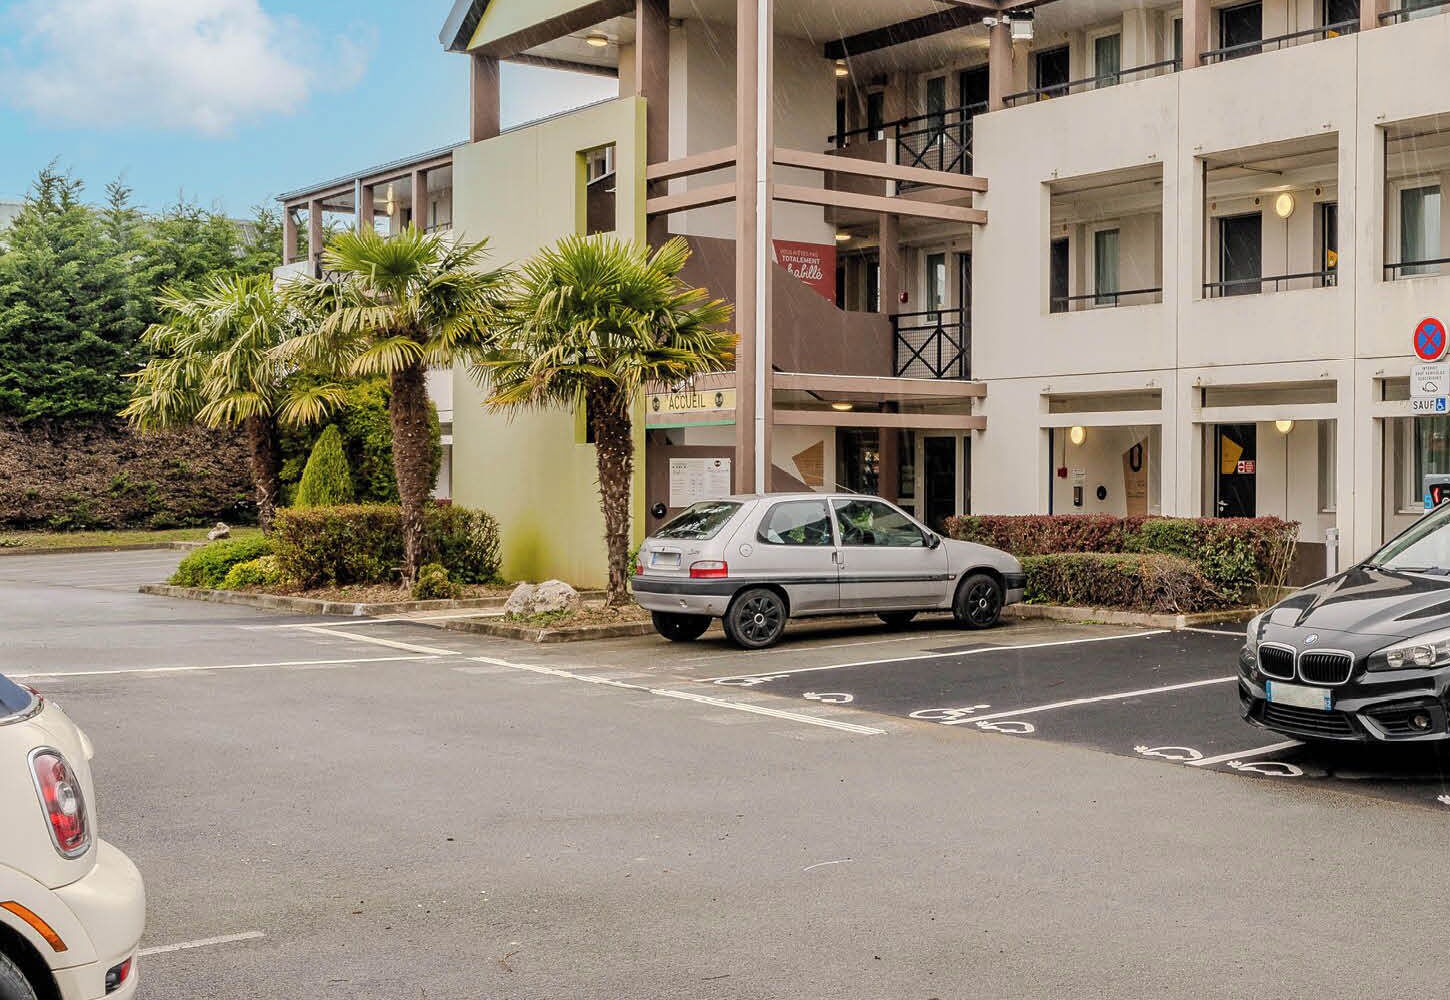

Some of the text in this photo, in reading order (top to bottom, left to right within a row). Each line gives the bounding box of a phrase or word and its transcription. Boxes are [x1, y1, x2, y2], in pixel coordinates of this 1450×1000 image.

[782, 255, 820, 264] TOTALEMENT
[787, 263, 823, 280] habillé
[669, 393, 706, 411] ACCUEIL
[1413, 400, 1434, 410] SAUF
